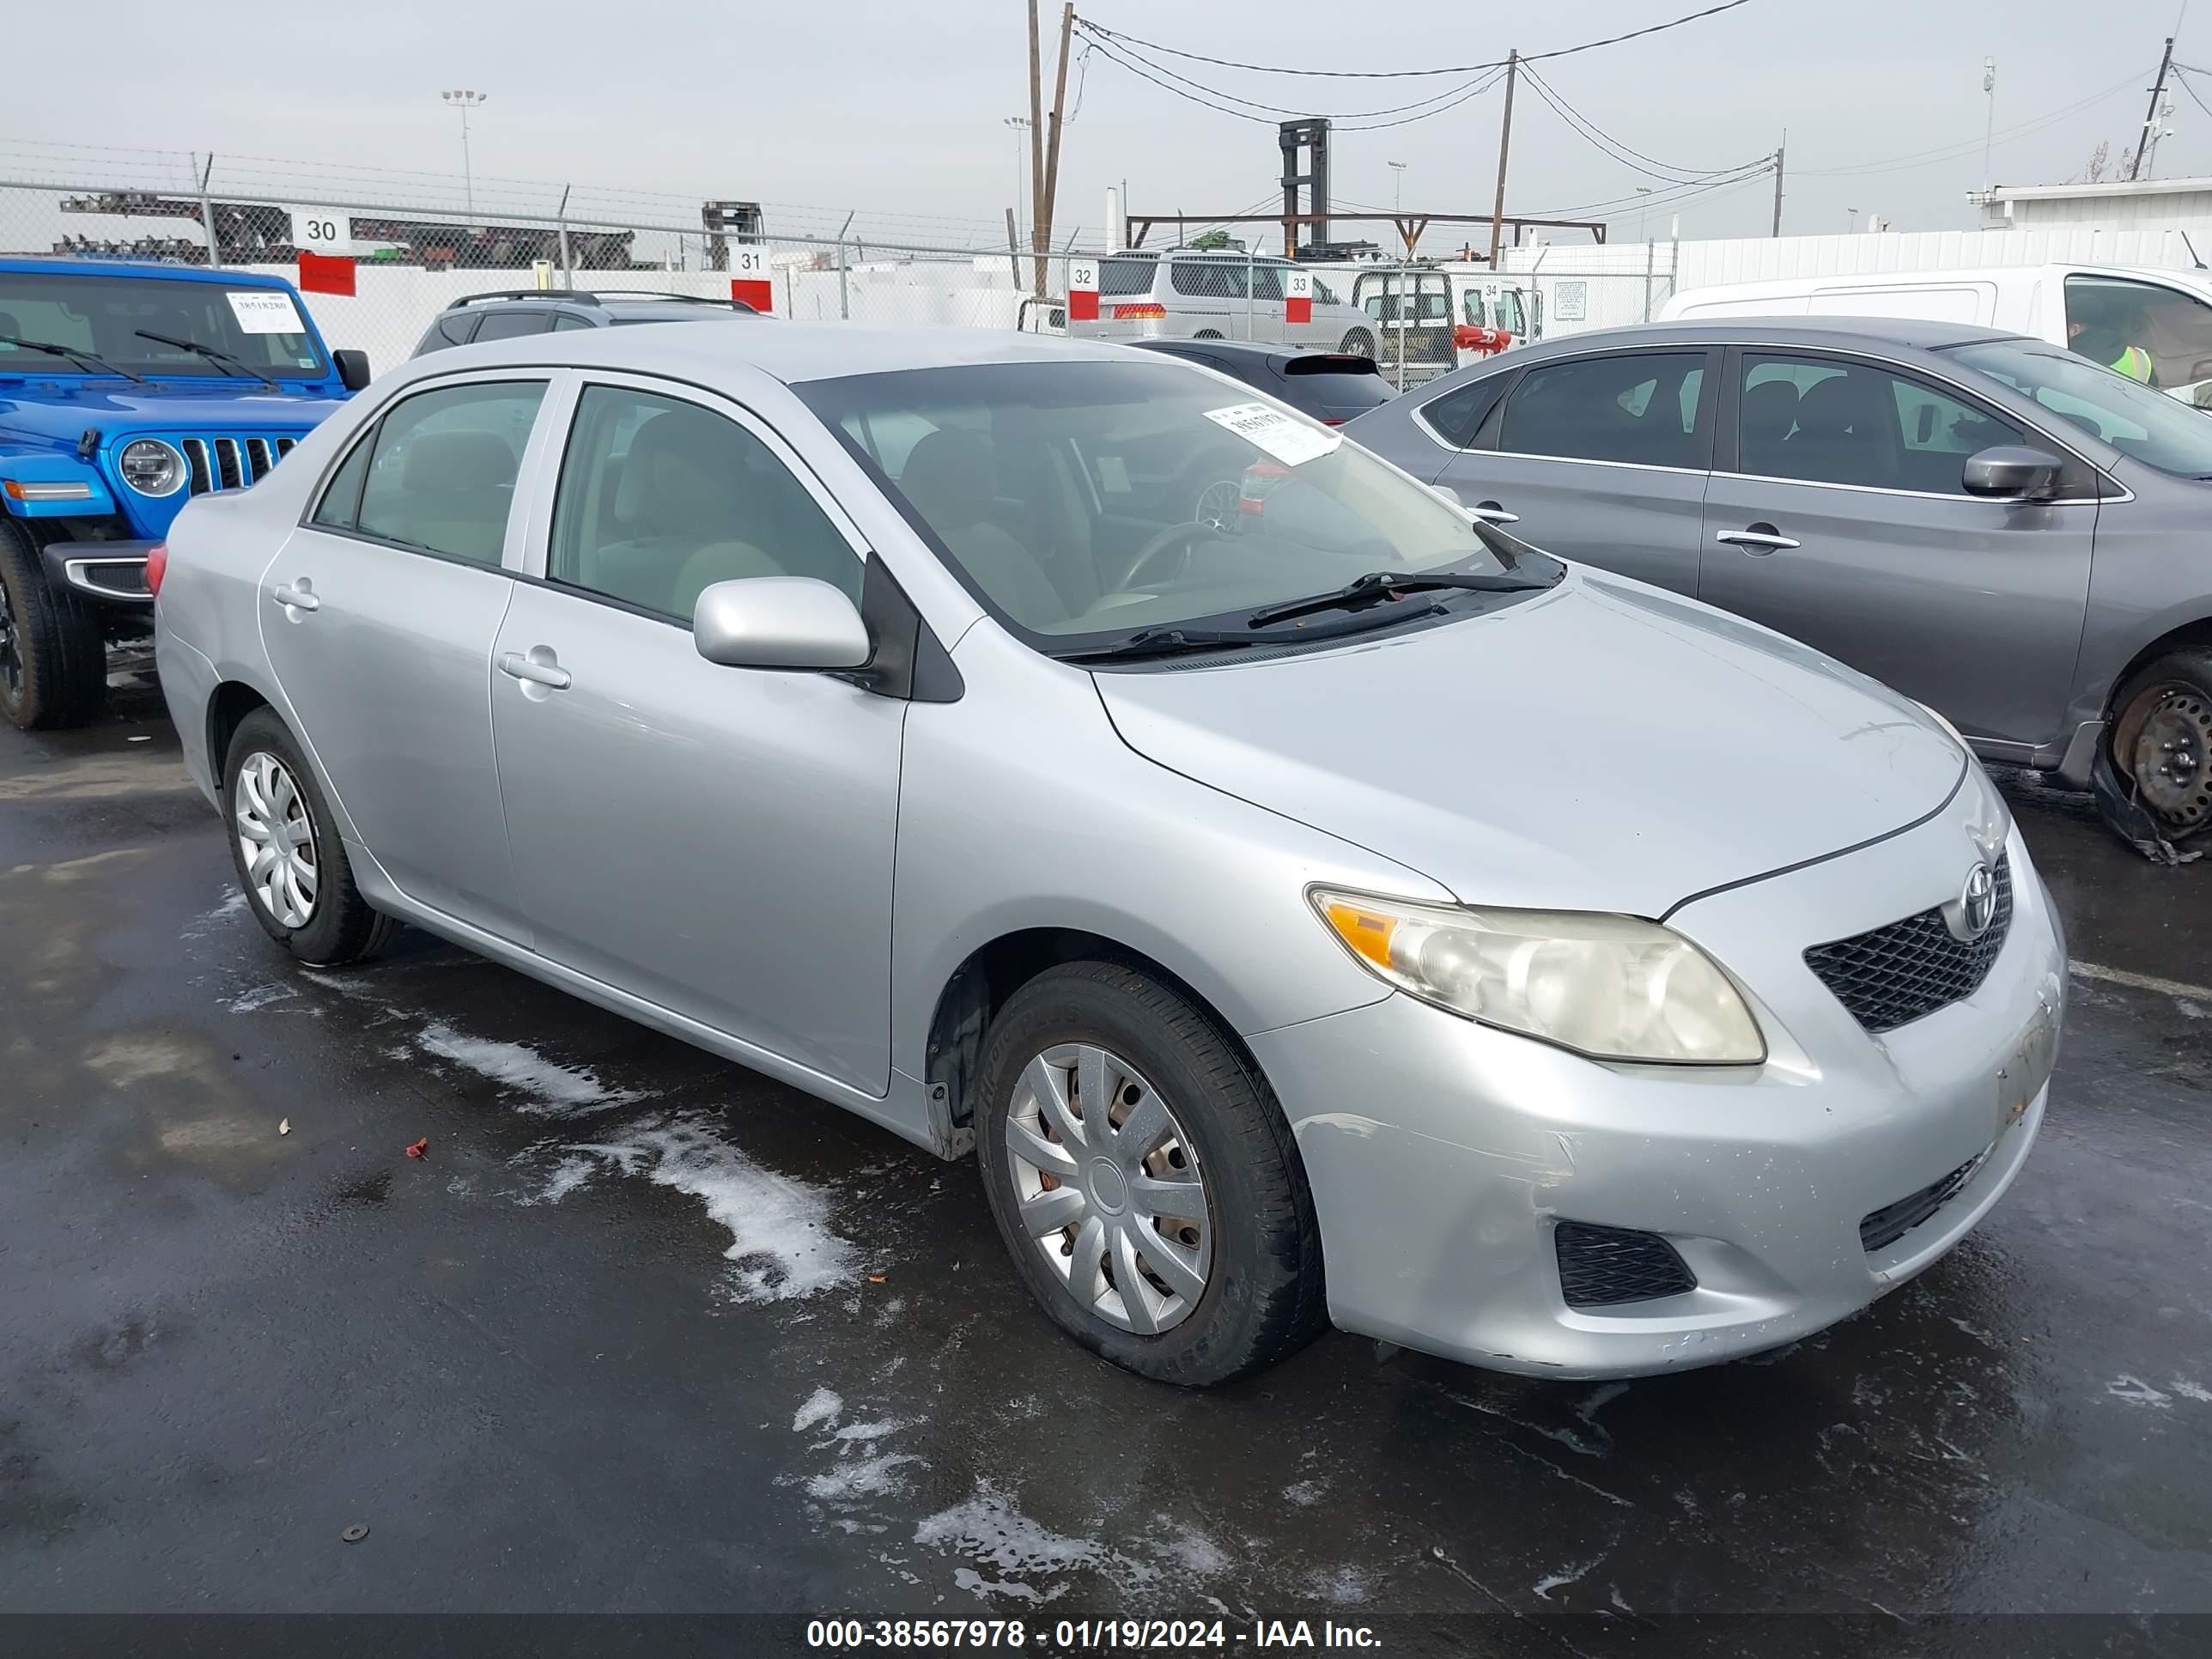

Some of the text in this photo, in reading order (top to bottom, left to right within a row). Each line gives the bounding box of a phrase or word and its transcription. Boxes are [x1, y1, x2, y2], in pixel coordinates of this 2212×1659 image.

[307, 220, 336, 240] 30
[741, 252, 760, 270] 31
[1075, 269, 1091, 284] 32
[1293, 277, 1306, 291] 33
[1486, 284, 1497, 296] 34
[1231, 413, 1287, 432] 38567978
